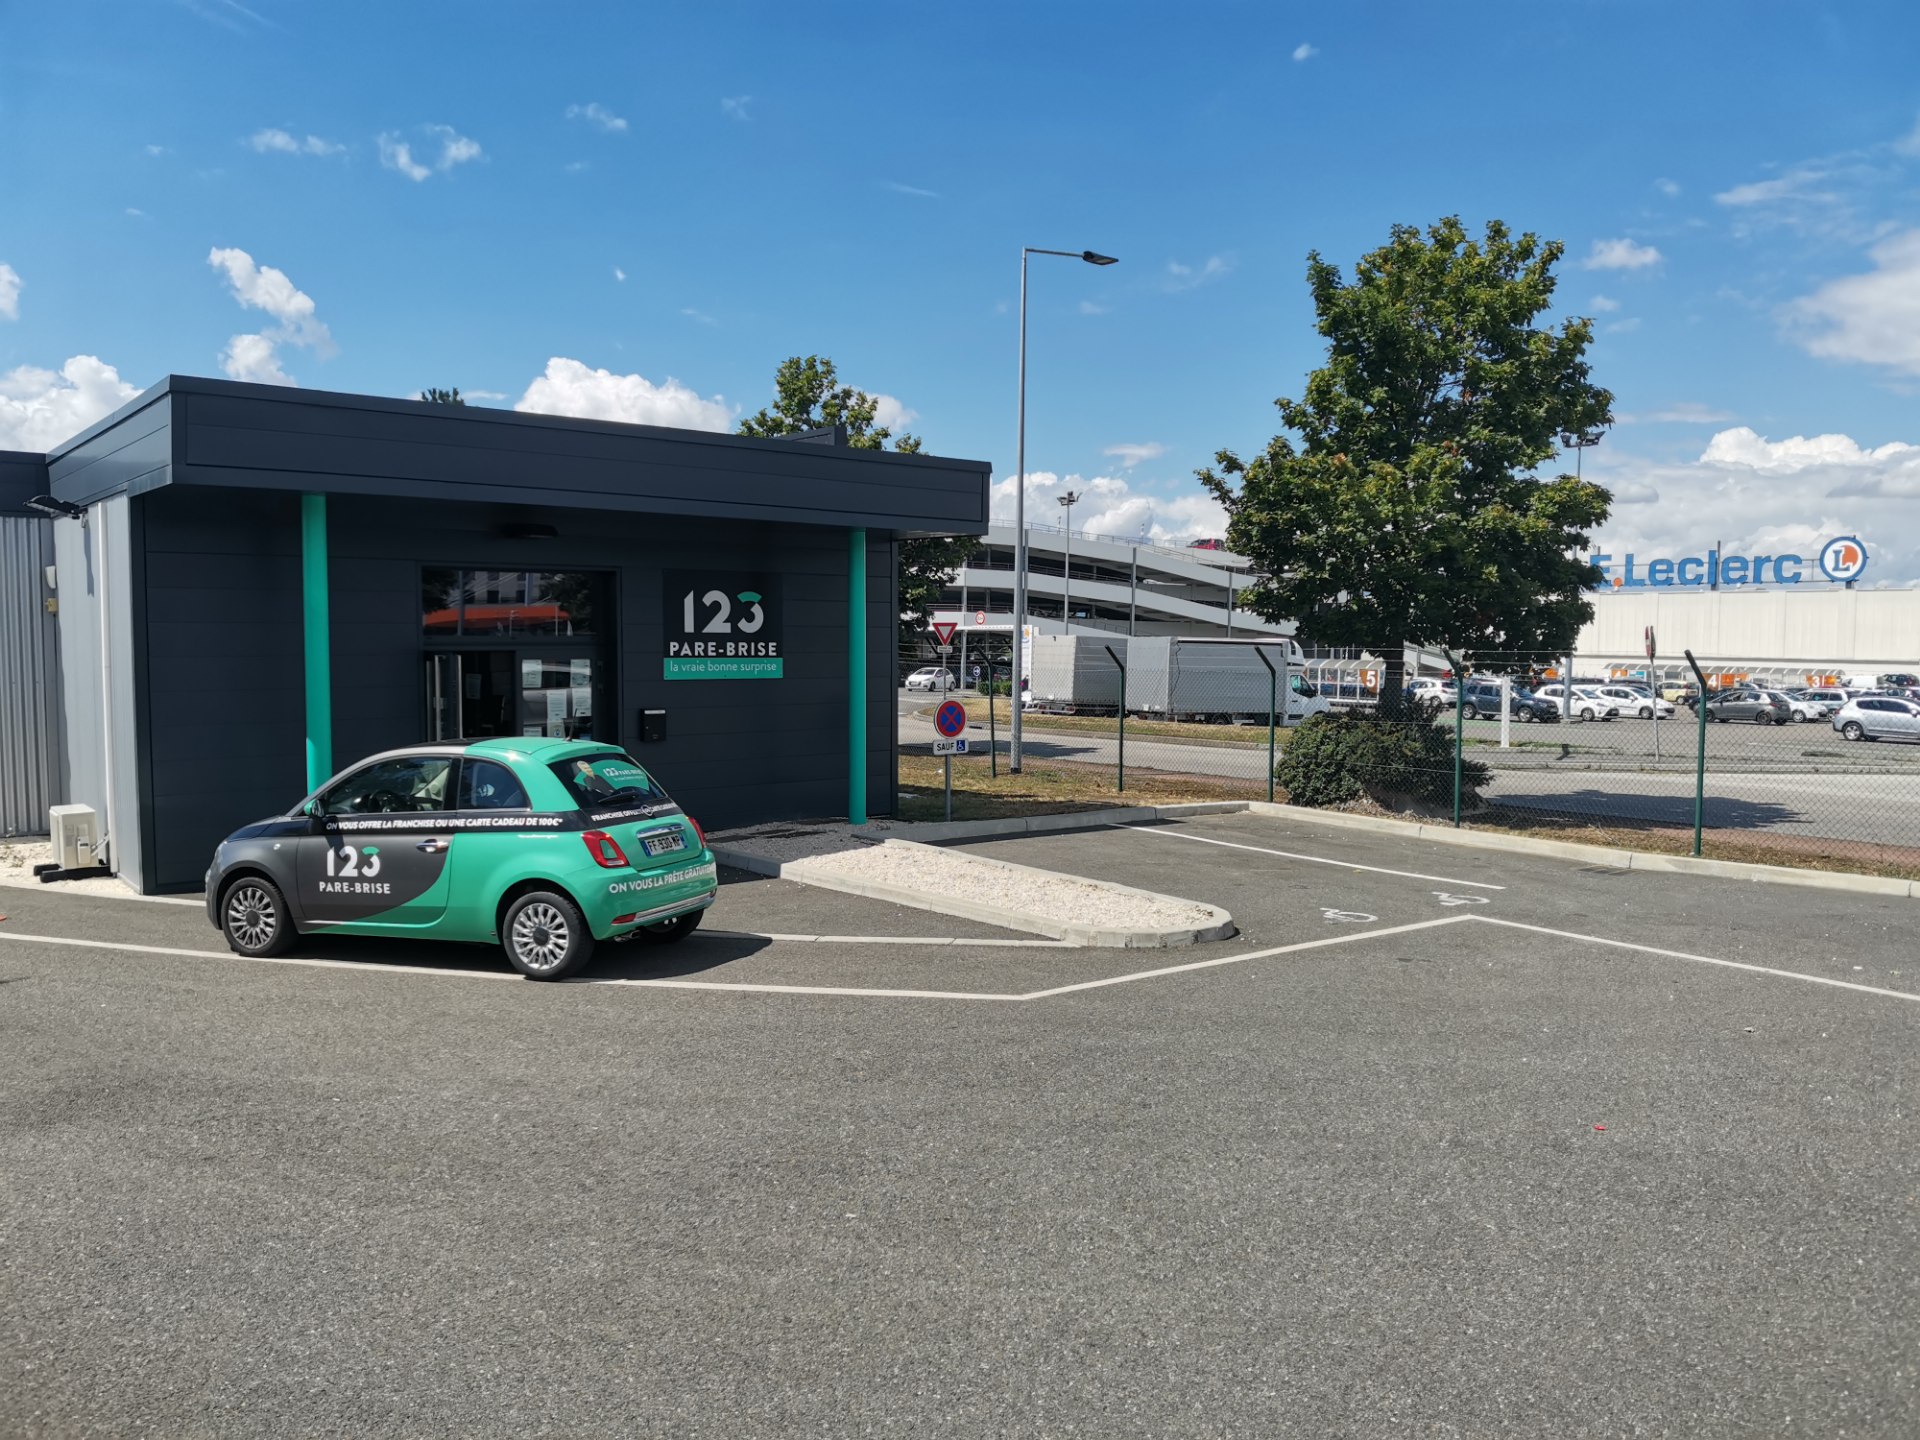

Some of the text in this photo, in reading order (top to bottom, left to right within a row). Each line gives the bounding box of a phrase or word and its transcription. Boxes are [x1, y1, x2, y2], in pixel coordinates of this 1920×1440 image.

[683, 589, 764, 634] 123
[669, 641, 778, 656] PARE-BRISE
[670, 660, 777, 675] la vraie bonne surprise
[1366, 671, 1376, 688] 5
[1707, 674, 1718, 688] 4
[1812, 676, 1820, 688] 3
[936, 741, 955, 752] SAUF
[326, 822, 338, 830] ON
[338, 821, 358, 830] VOUS
[358, 820, 382, 829] OFFRE
[382, 820, 392, 829] LA
[392, 819, 435, 828] FRANCHISE
[435, 819, 448, 828] OU
[448, 819, 466, 827] UNE
[466, 818, 492, 827] CARTE
[492, 818, 525, 827] CADEAU
[525, 817, 538, 826] DE
[590, 811, 625, 822] FRANCHISE
[327, 845, 381, 877] 123
[319, 881, 391, 894] PARE-BRISE
[608, 882, 628, 894] ON
[628, 878, 653, 891] VOUS
[654, 875, 664, 887] LA
[664, 870, 684, 885] PRÊTE
